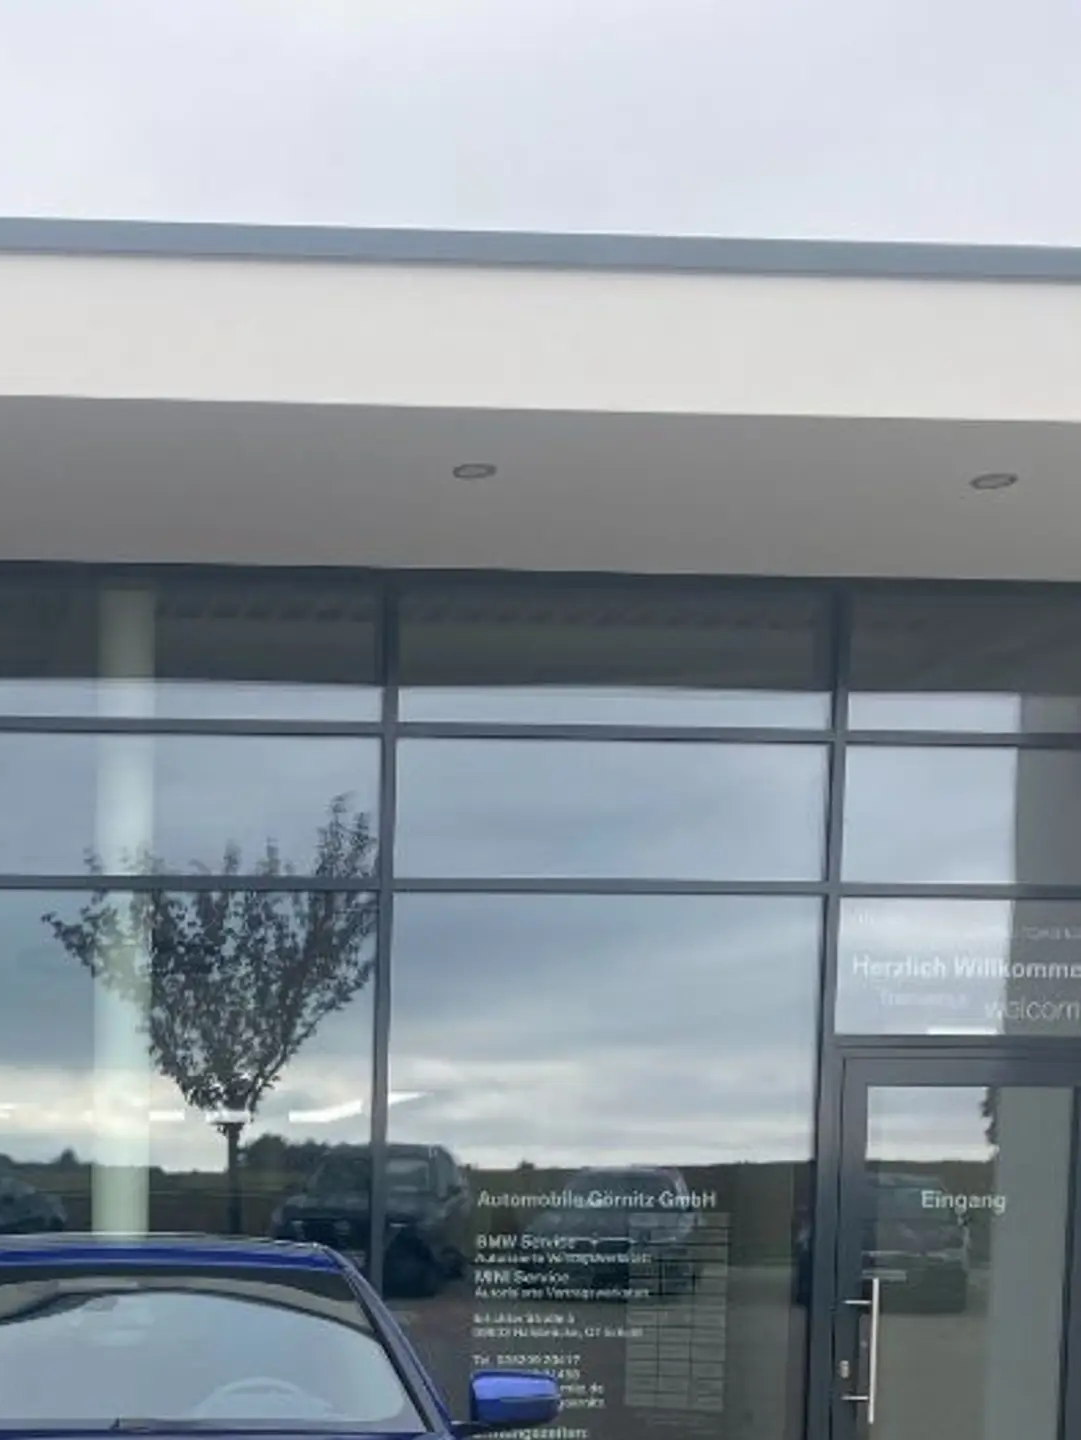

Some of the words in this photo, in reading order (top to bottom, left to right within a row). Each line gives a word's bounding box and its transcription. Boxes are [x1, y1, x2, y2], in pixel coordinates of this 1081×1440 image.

[852, 954, 946, 978] Herzlich
[476, 1190, 587, 1209] Automobile
[588, 1188, 655, 1208] Görnitz
[658, 1189, 717, 1208] GmbH
[921, 1190, 1006, 1213] Eingang
[476, 1234, 517, 1249] BMW
[521, 1234, 575, 1249] Service
[474, 1269, 510, 1284] MINI
[514, 1269, 570, 1283] Service
